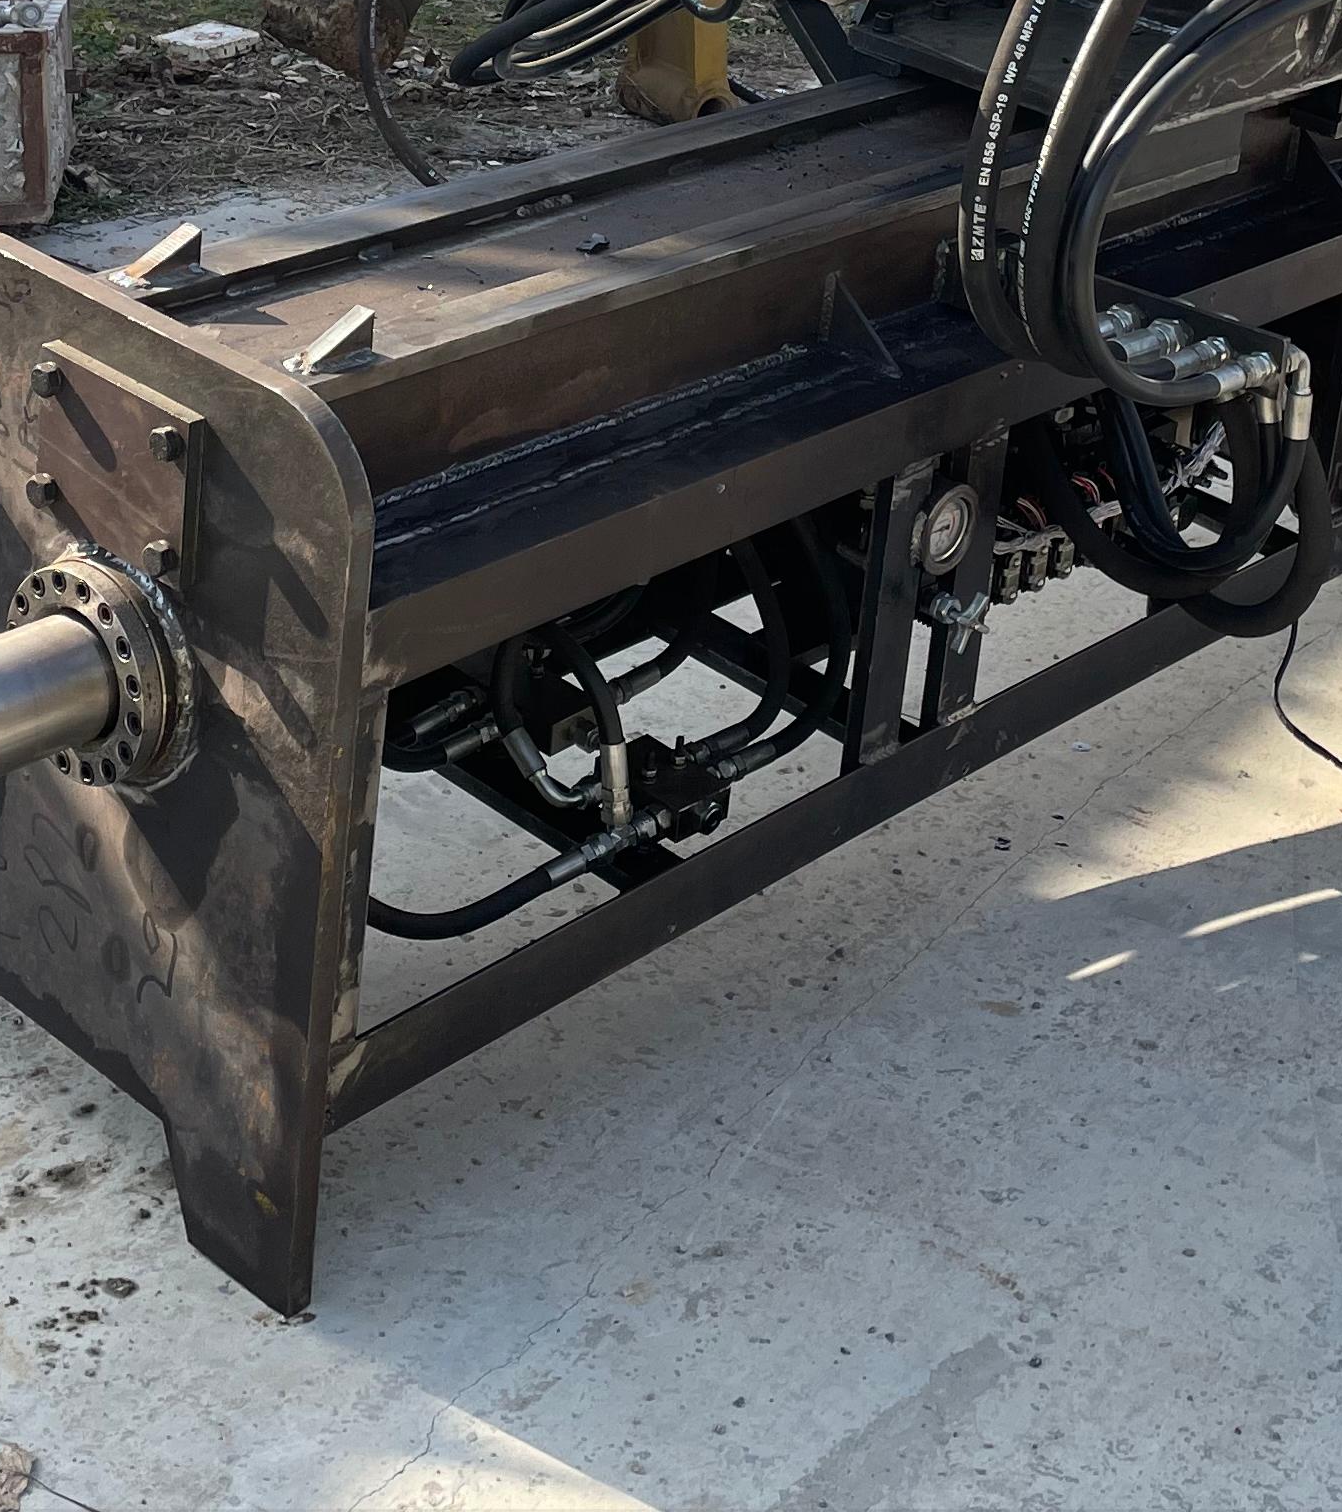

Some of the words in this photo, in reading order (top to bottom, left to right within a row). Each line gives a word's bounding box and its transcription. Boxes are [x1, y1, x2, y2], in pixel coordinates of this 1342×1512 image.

[1020, 14, 1038, 42] MPa
[1013, 43, 1027, 60] 46
[1003, 61, 1018, 84] WP
[988, 93, 1008, 140] 4SP-19
[982, 141, 996, 164] 856
[978, 167, 991, 186] EN
